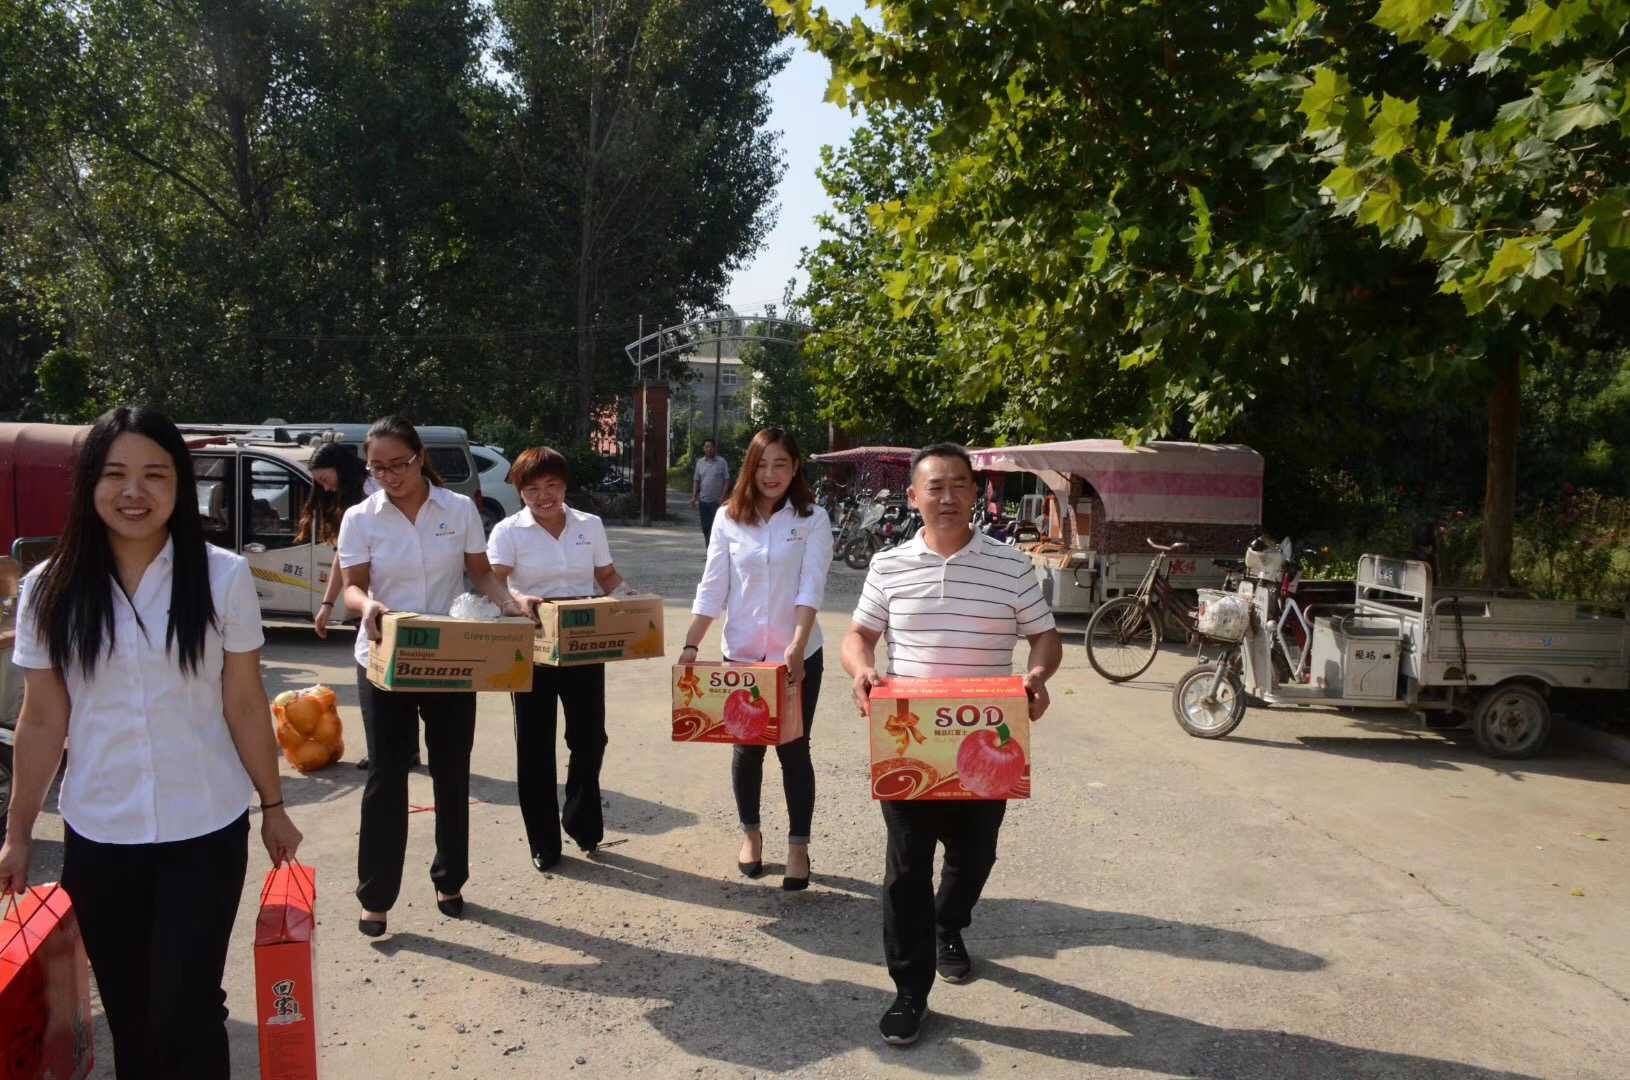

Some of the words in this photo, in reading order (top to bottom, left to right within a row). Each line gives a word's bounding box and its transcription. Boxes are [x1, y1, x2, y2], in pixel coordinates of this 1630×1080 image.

[567, 639, 625, 652] Banana
[396, 662, 474, 677] Banana
[710, 671, 756, 687] SOD
[934, 705, 1004, 727] SOD
